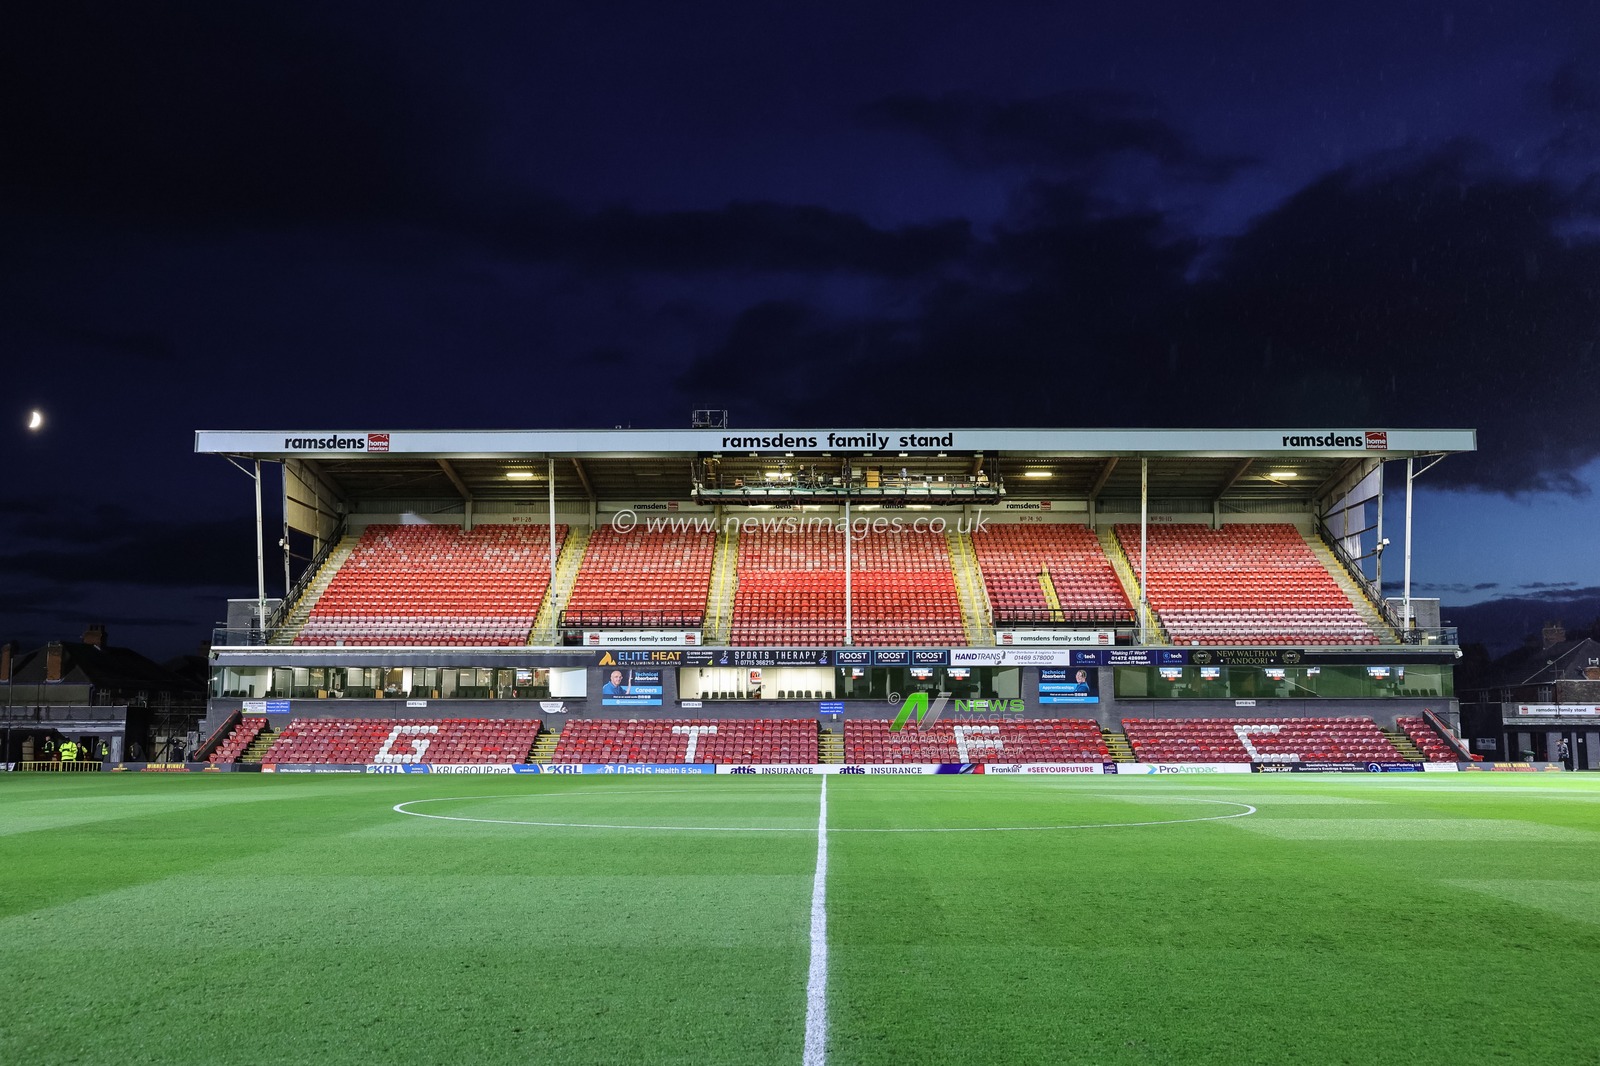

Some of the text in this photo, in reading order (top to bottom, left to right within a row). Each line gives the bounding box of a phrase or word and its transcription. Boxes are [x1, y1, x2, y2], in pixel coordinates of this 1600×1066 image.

[284, 434, 364, 448] ramsdens
[723, 433, 953, 449] ramsdens family stand
[1282, 433, 1363, 446] ramsdens
[618, 652, 649, 660] ELITE
[652, 652, 682, 660] HEAT
[553, 765, 581, 774] KRL
[618, 765, 652, 774] Oasis
[731, 765, 756, 774] attis
[840, 765, 865, 774] attis
